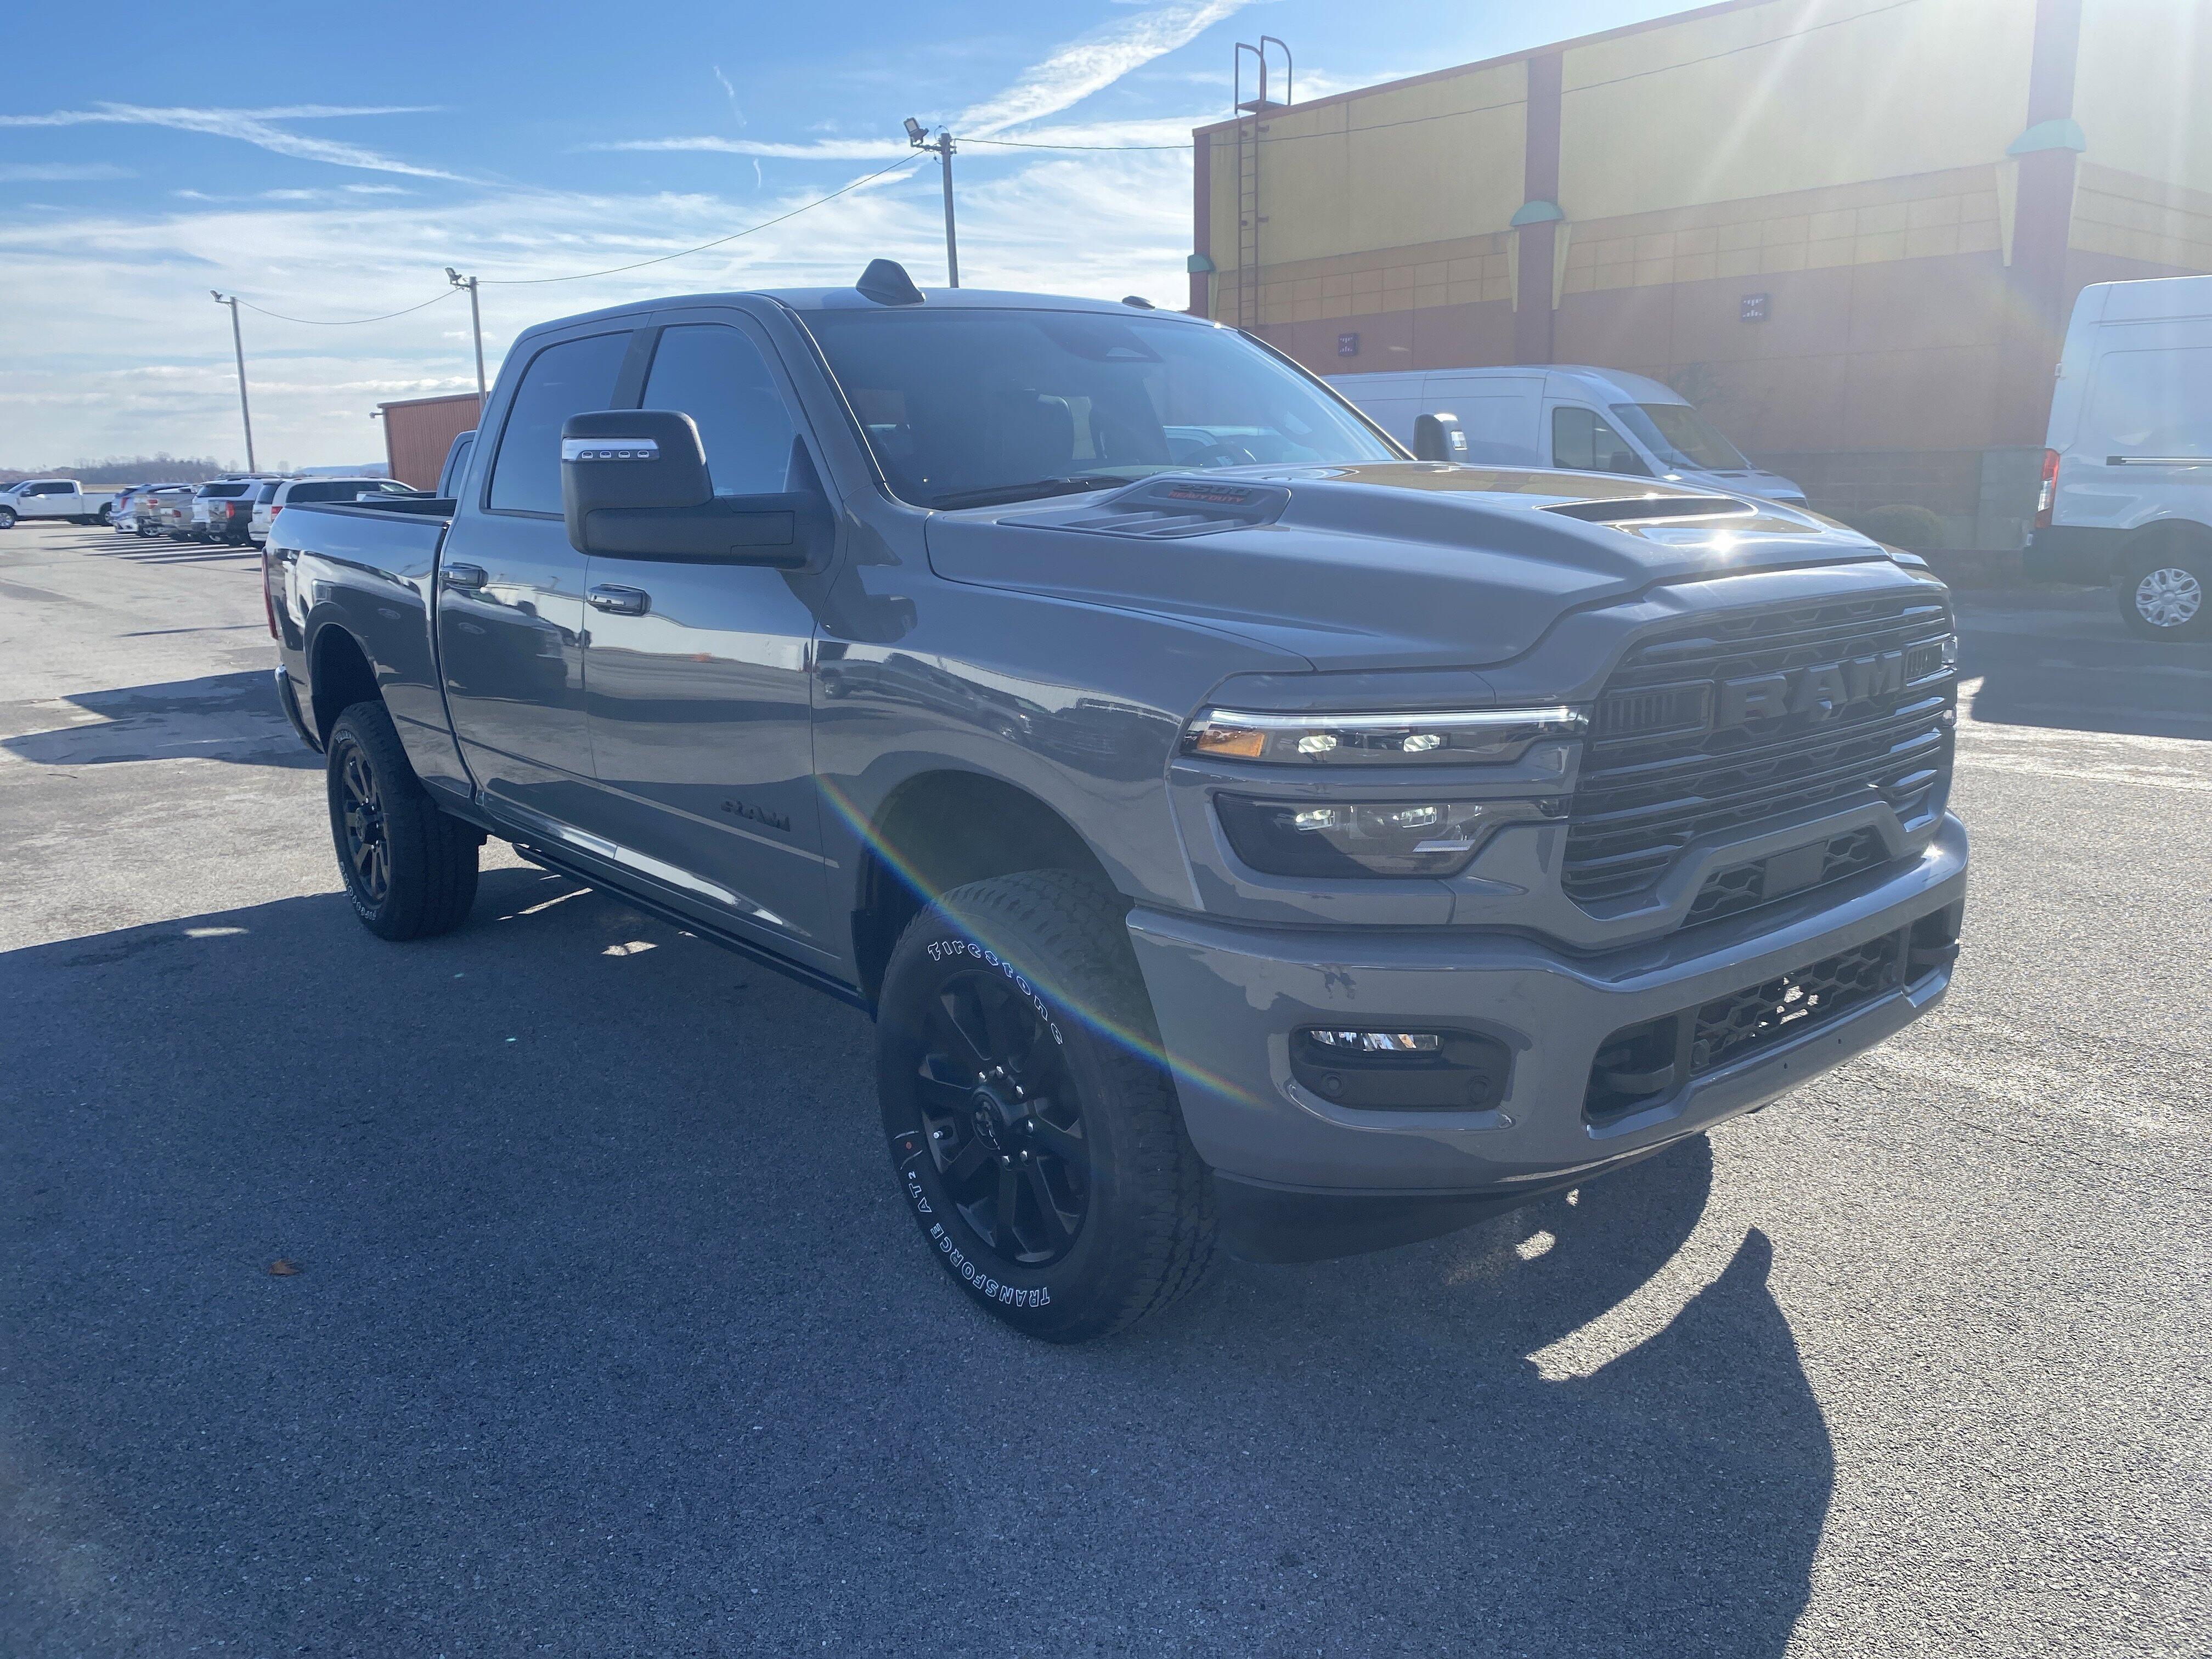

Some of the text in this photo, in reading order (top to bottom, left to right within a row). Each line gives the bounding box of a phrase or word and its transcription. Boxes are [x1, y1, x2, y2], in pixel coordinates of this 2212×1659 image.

[1167, 491, 1245, 503] HEAVY DUTY
[1172, 482, 1253, 498] 2500
[1720, 650, 1902, 723] RAM
[927, 940, 1063, 1045] Firestone
[930, 1222, 1051, 1307] TRANSFORCE
